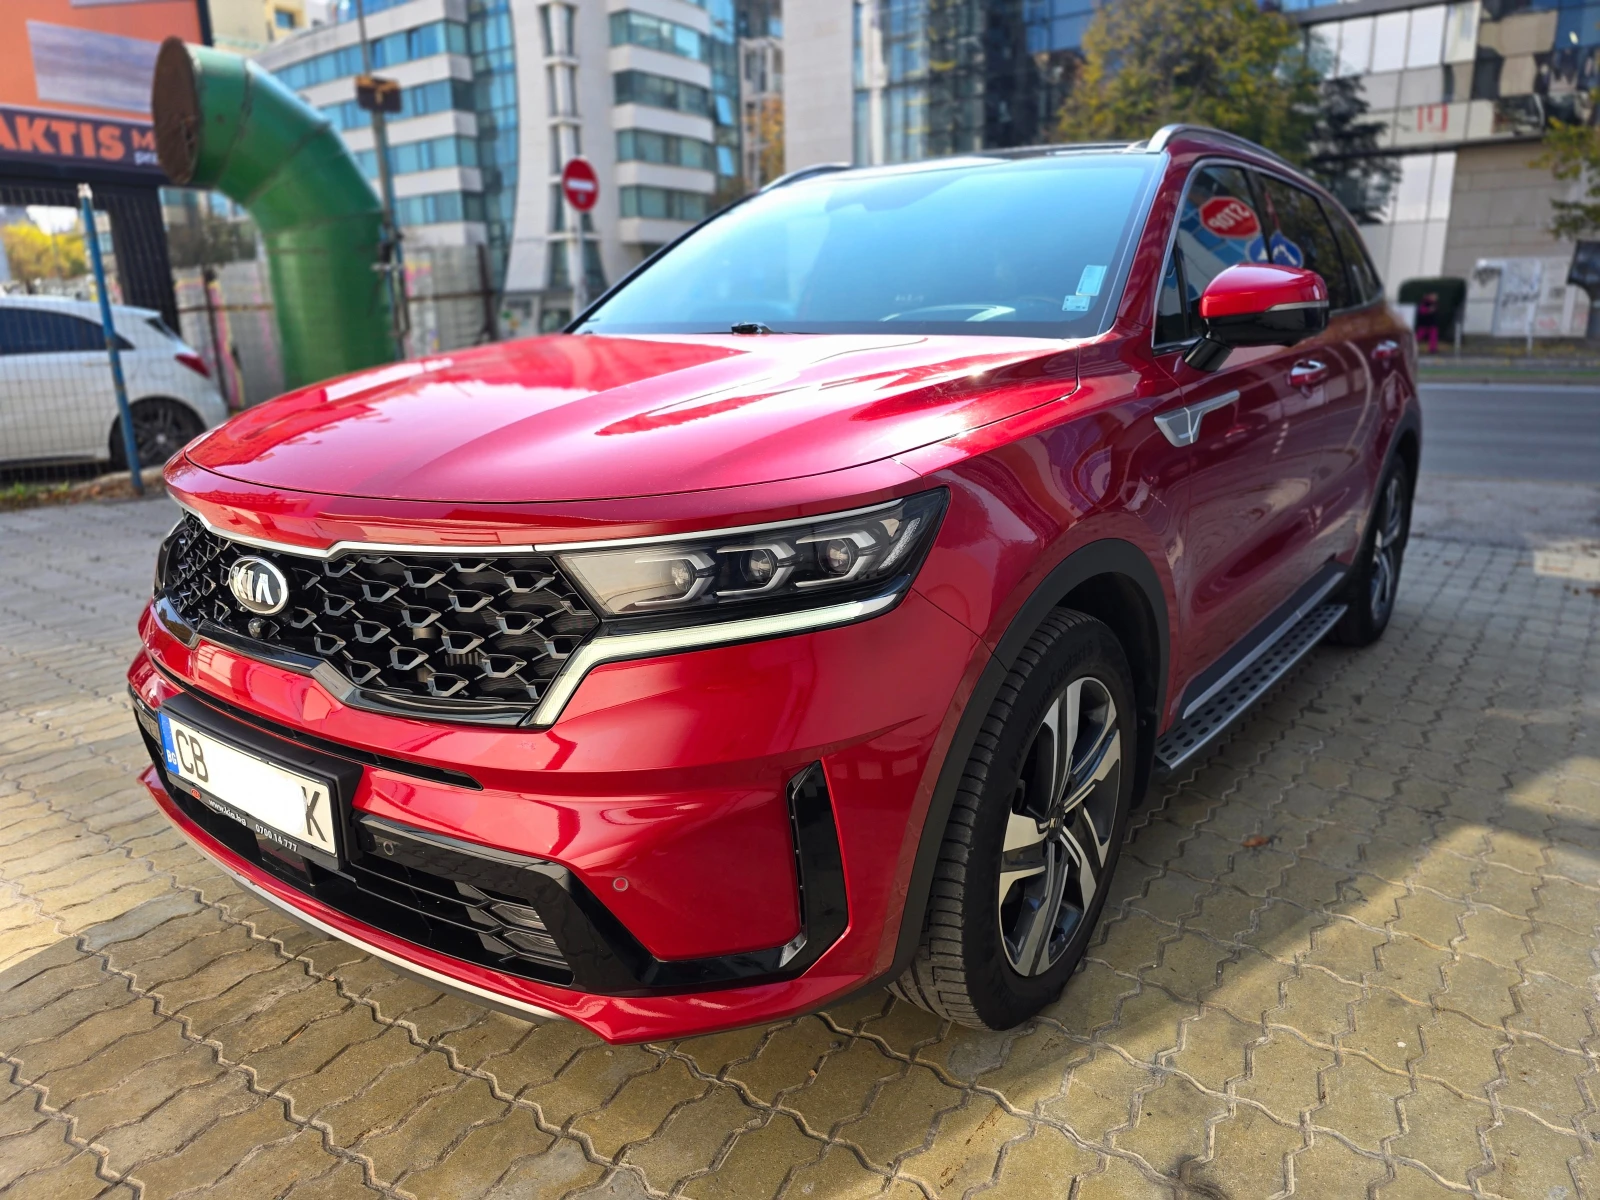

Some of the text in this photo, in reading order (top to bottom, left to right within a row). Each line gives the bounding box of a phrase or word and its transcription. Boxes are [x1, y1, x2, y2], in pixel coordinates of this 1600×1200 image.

[231, 566, 275, 606] KIA
[166, 750, 177, 765] BG
[175, 729, 327, 843] CB K
